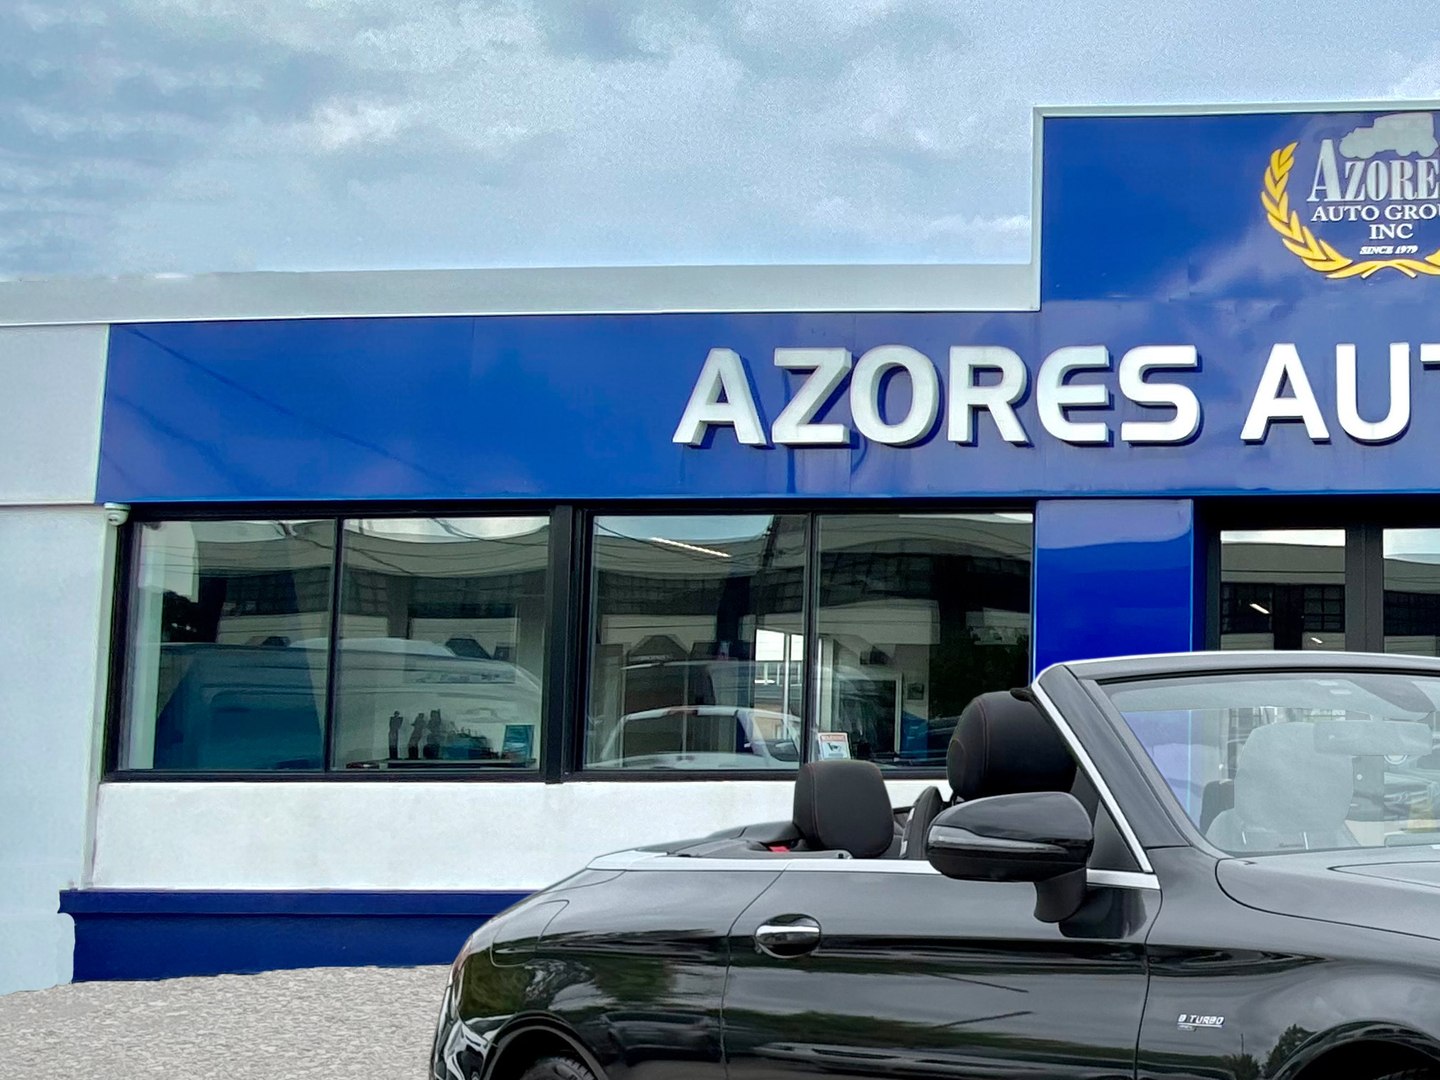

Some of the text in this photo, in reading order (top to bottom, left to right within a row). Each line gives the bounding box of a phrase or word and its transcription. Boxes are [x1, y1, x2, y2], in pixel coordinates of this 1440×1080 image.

[1311, 204, 1379, 221] AUTO
[1368, 223, 1414, 239] INC
[1359, 245, 1419, 255] SINCE 1979
[672, 344, 1202, 446] AZORES
